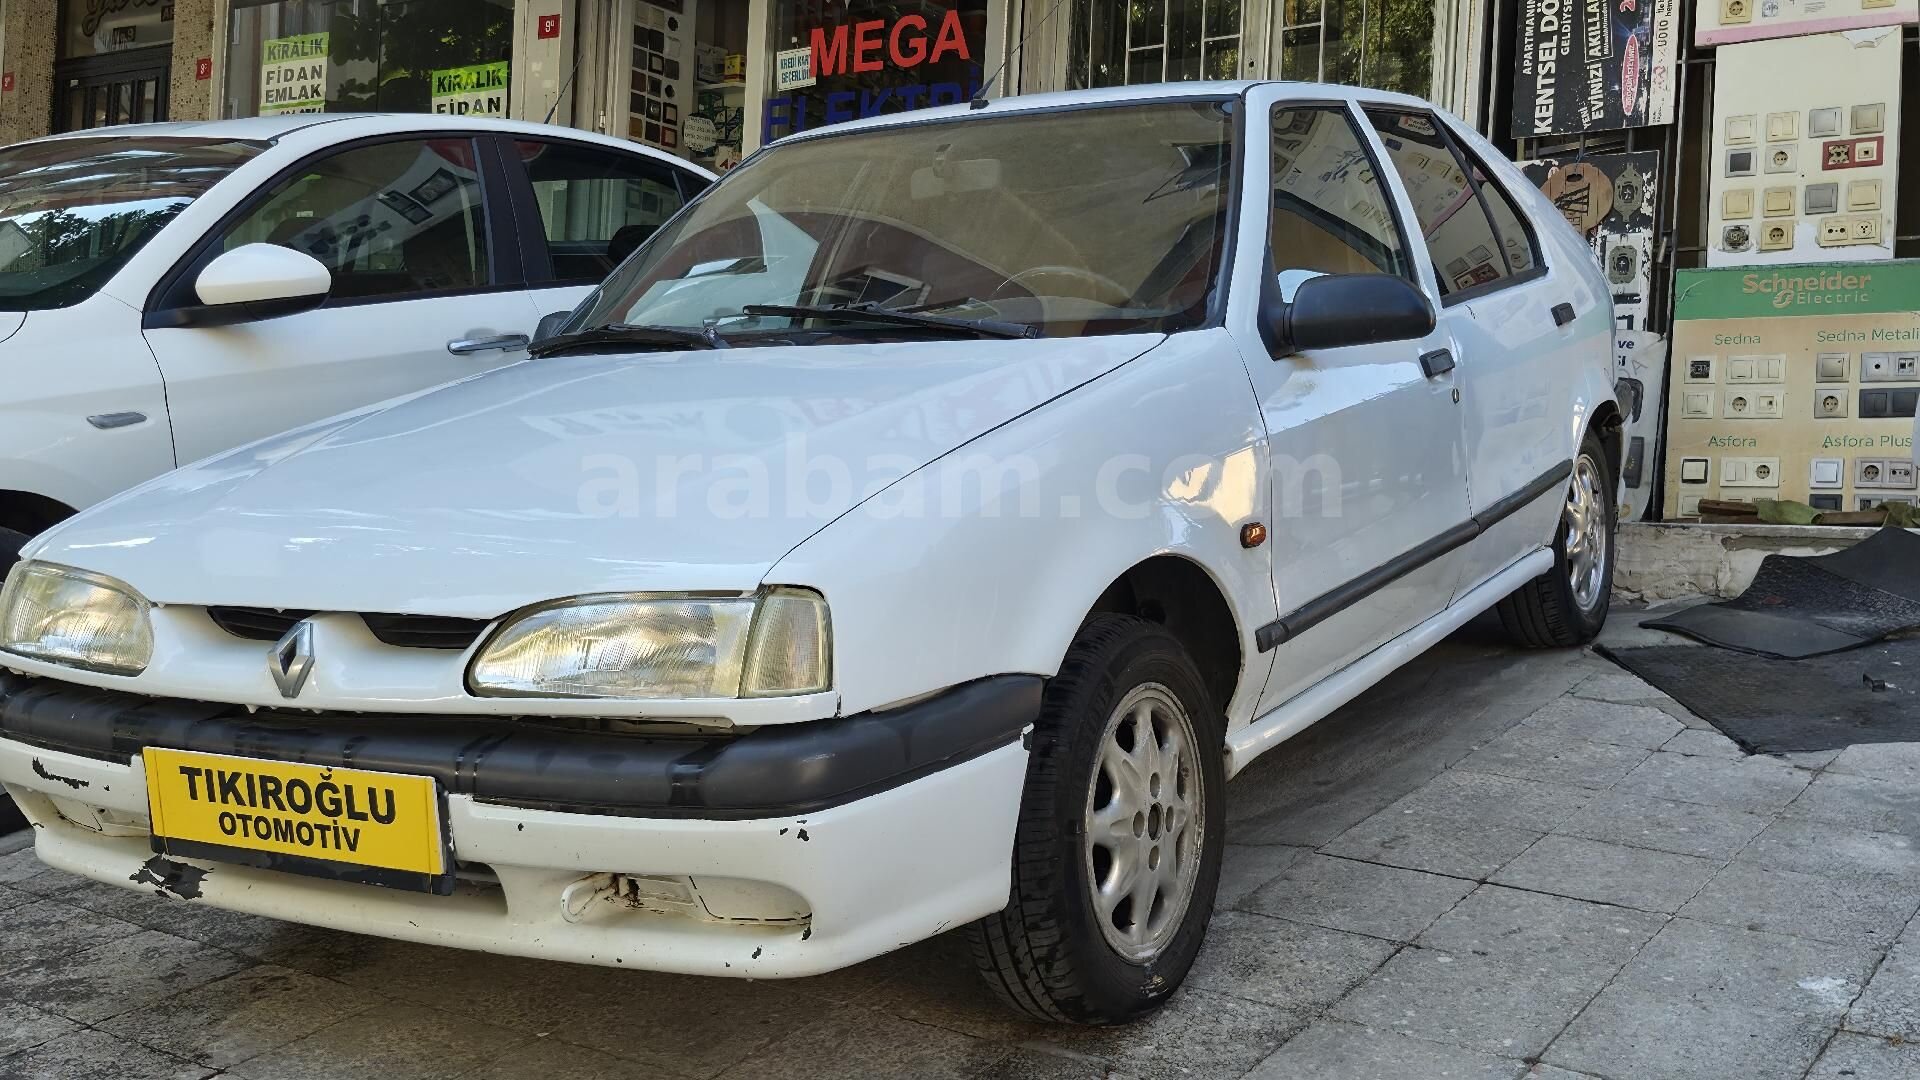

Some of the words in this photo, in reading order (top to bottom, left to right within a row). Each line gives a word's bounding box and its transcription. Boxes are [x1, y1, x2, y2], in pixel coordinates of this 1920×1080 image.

[267, 36, 324, 62] KİRALIK
[809, 9, 971, 78] MEGA
[265, 63, 323, 86] FİDAN
[437, 69, 503, 93] KİRALIK
[1533, 35, 1558, 135] KENTSEL
[264, 82, 322, 104] EMLAK
[1586, 63, 1604, 121] EVİNİZİ
[1578, 105, 1592, 130] YENİ
[1742, 271, 1872, 294] Schneider
[1796, 290, 1869, 305] Electric
[1714, 332, 1761, 346] Sedna
[1816, 329, 1866, 344] Sedna
[1708, 434, 1757, 448] Asfora
[1822, 434, 1874, 449] Asfora
[1880, 434, 1912, 448] Plus
[178, 765, 397, 825] TIKIROĞLU
[218, 811, 361, 852] OTOMOTİV
